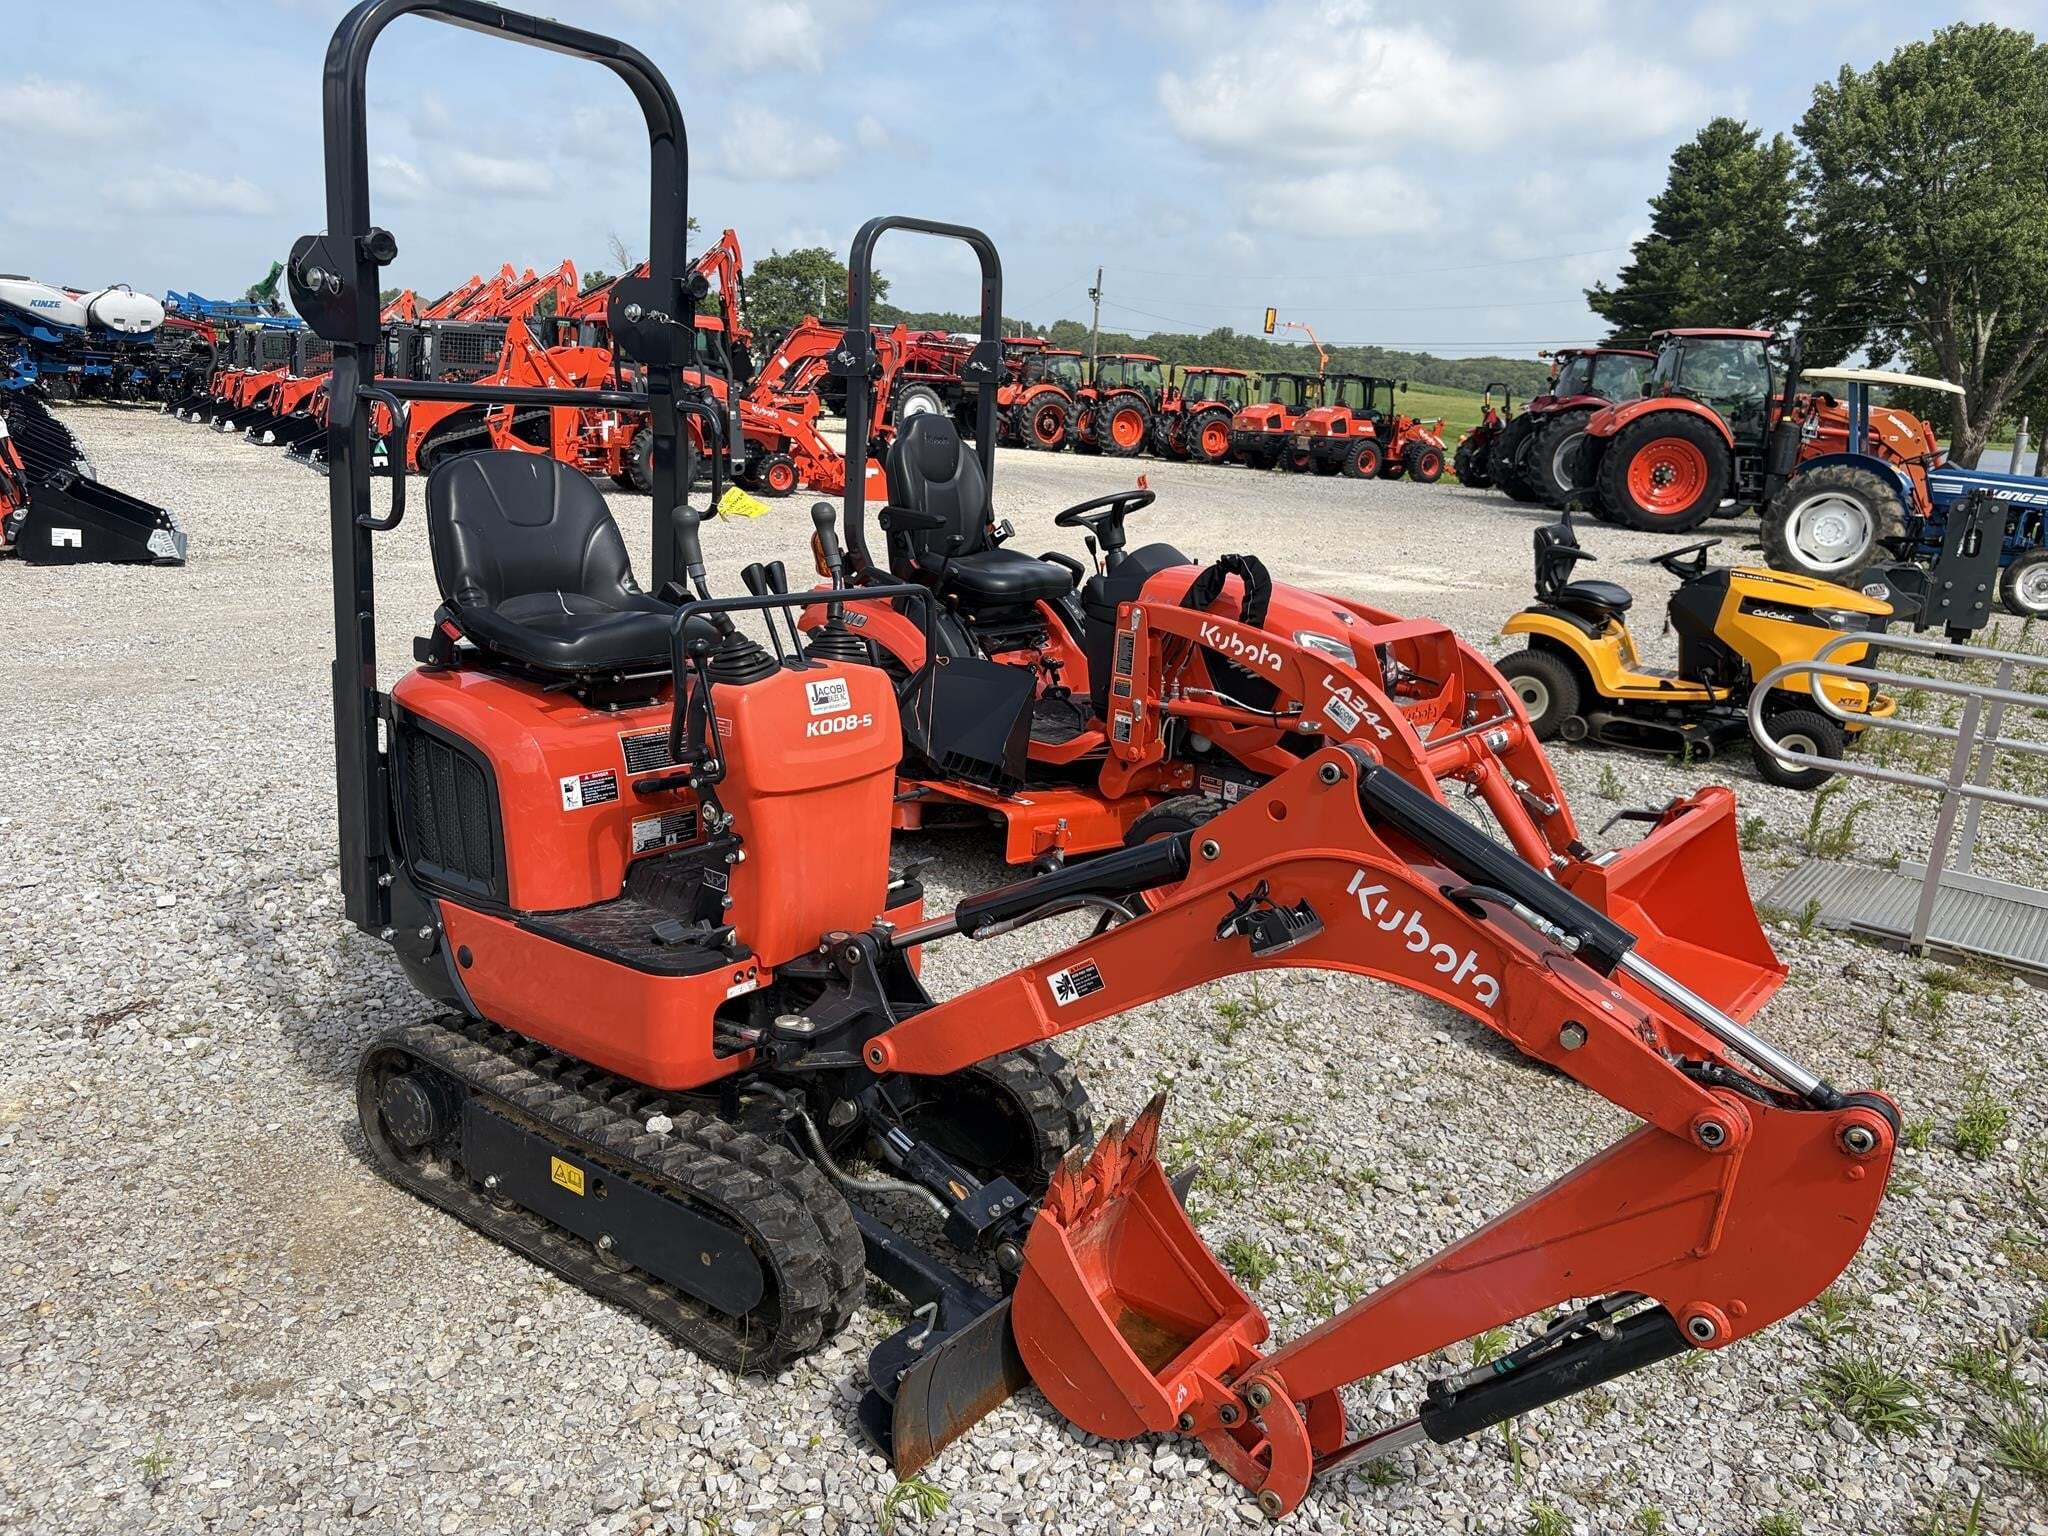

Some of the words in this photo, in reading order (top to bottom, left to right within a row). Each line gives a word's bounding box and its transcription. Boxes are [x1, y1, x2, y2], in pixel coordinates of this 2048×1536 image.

[30, 299, 61, 308] KINZE
[751, 403, 779, 419] Kubota
[1752, 609, 1768, 618] Cub
[1767, 611, 1795, 622] Cadet
[1200, 621, 1283, 672] Kubota
[811, 683, 846, 702] JACOBI
[1838, 697, 1864, 706] XT2
[1322, 674, 1393, 741] LA344
[806, 713, 873, 737] K008-5
[1346, 868, 1500, 1009] Kubota
